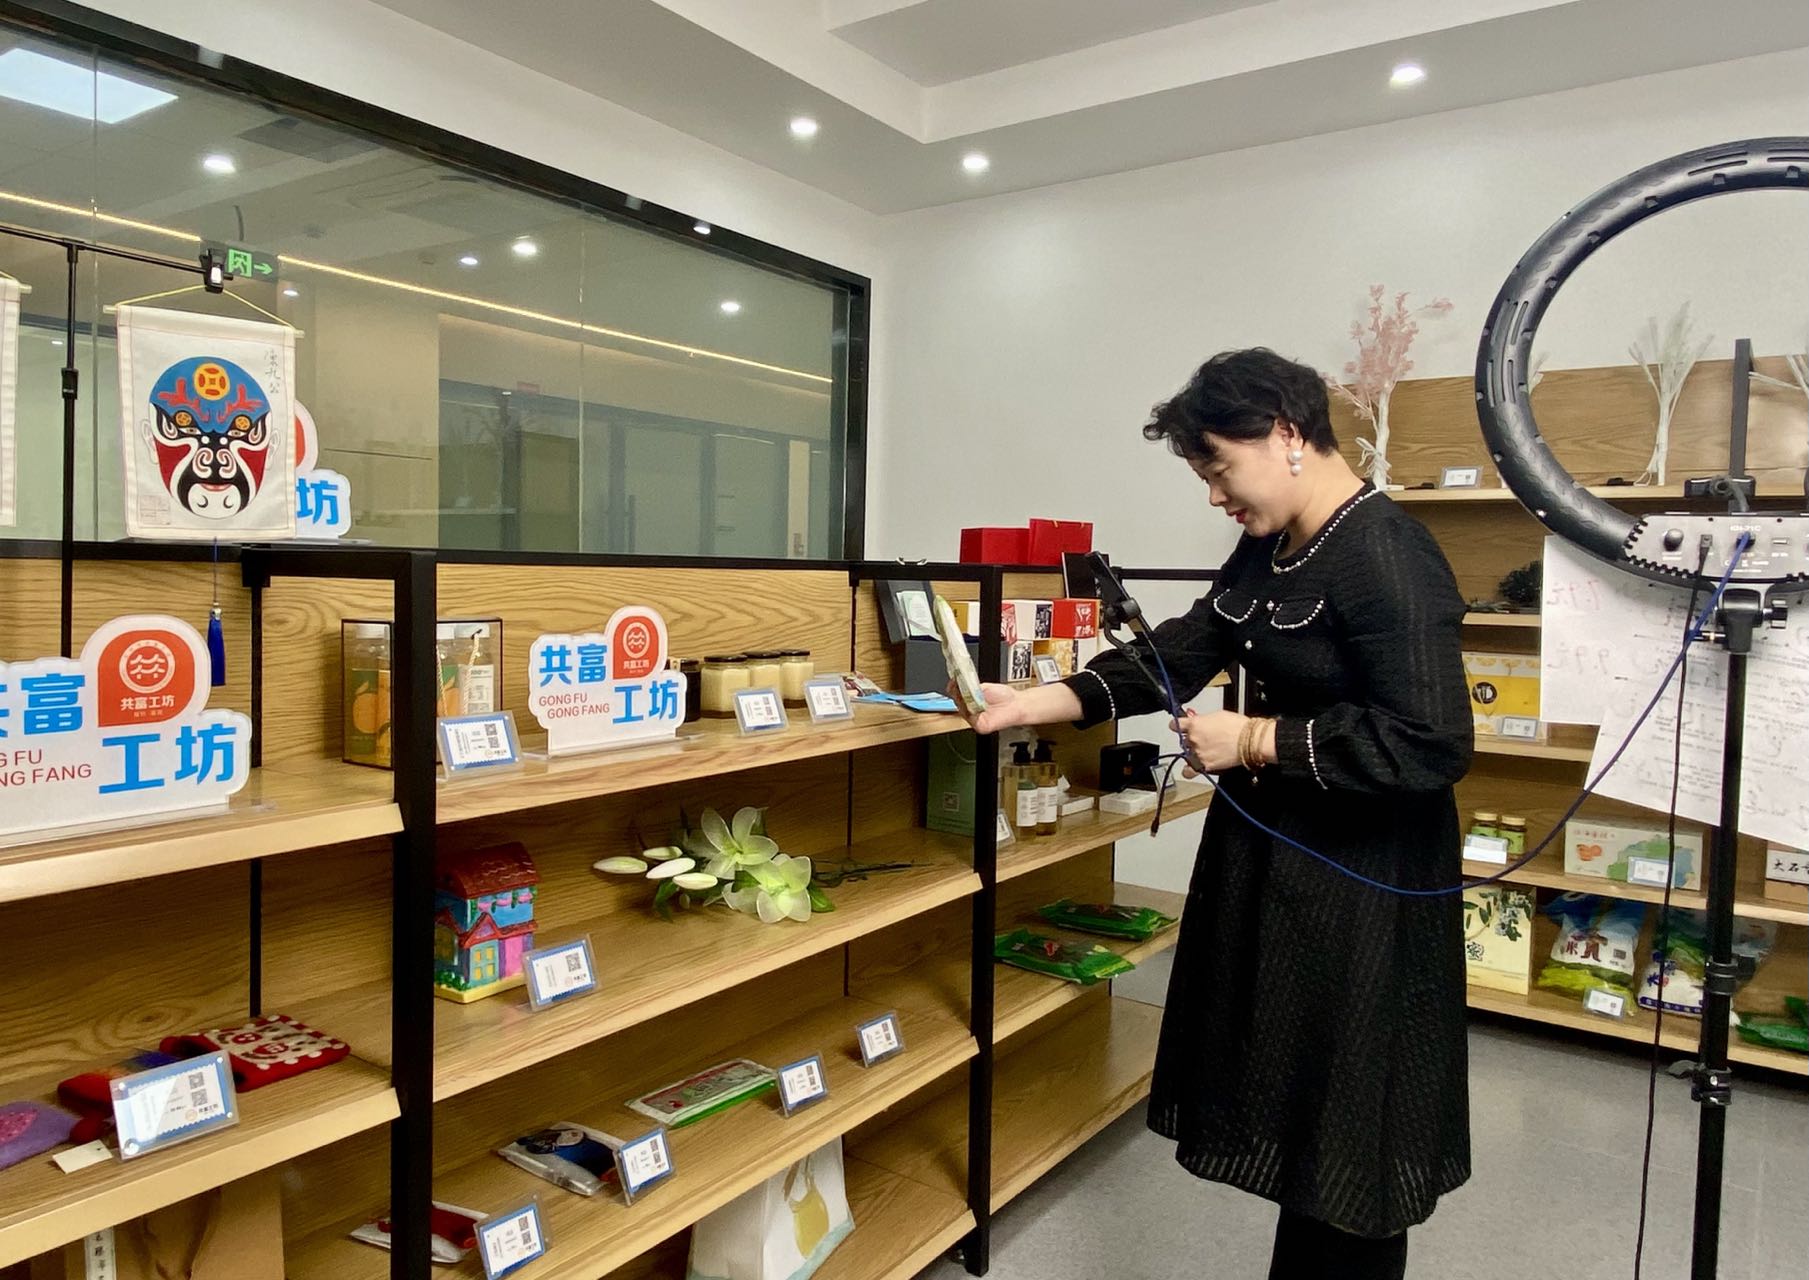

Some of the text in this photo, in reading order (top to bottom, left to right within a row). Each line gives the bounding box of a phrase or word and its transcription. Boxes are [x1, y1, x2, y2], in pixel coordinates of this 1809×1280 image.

[540, 644, 607, 687] 共富
[0, 673, 86, 738] 富
[120, 695, 175, 710] 共富工坊
[539, 693, 588, 707] GONG FU
[612, 679, 679, 724] 工坊
[547, 703, 610, 719] GONG FANG
[15, 749, 42, 766] FU
[99, 724, 236, 794] 工坊
[33, 763, 92, 784] FANG
